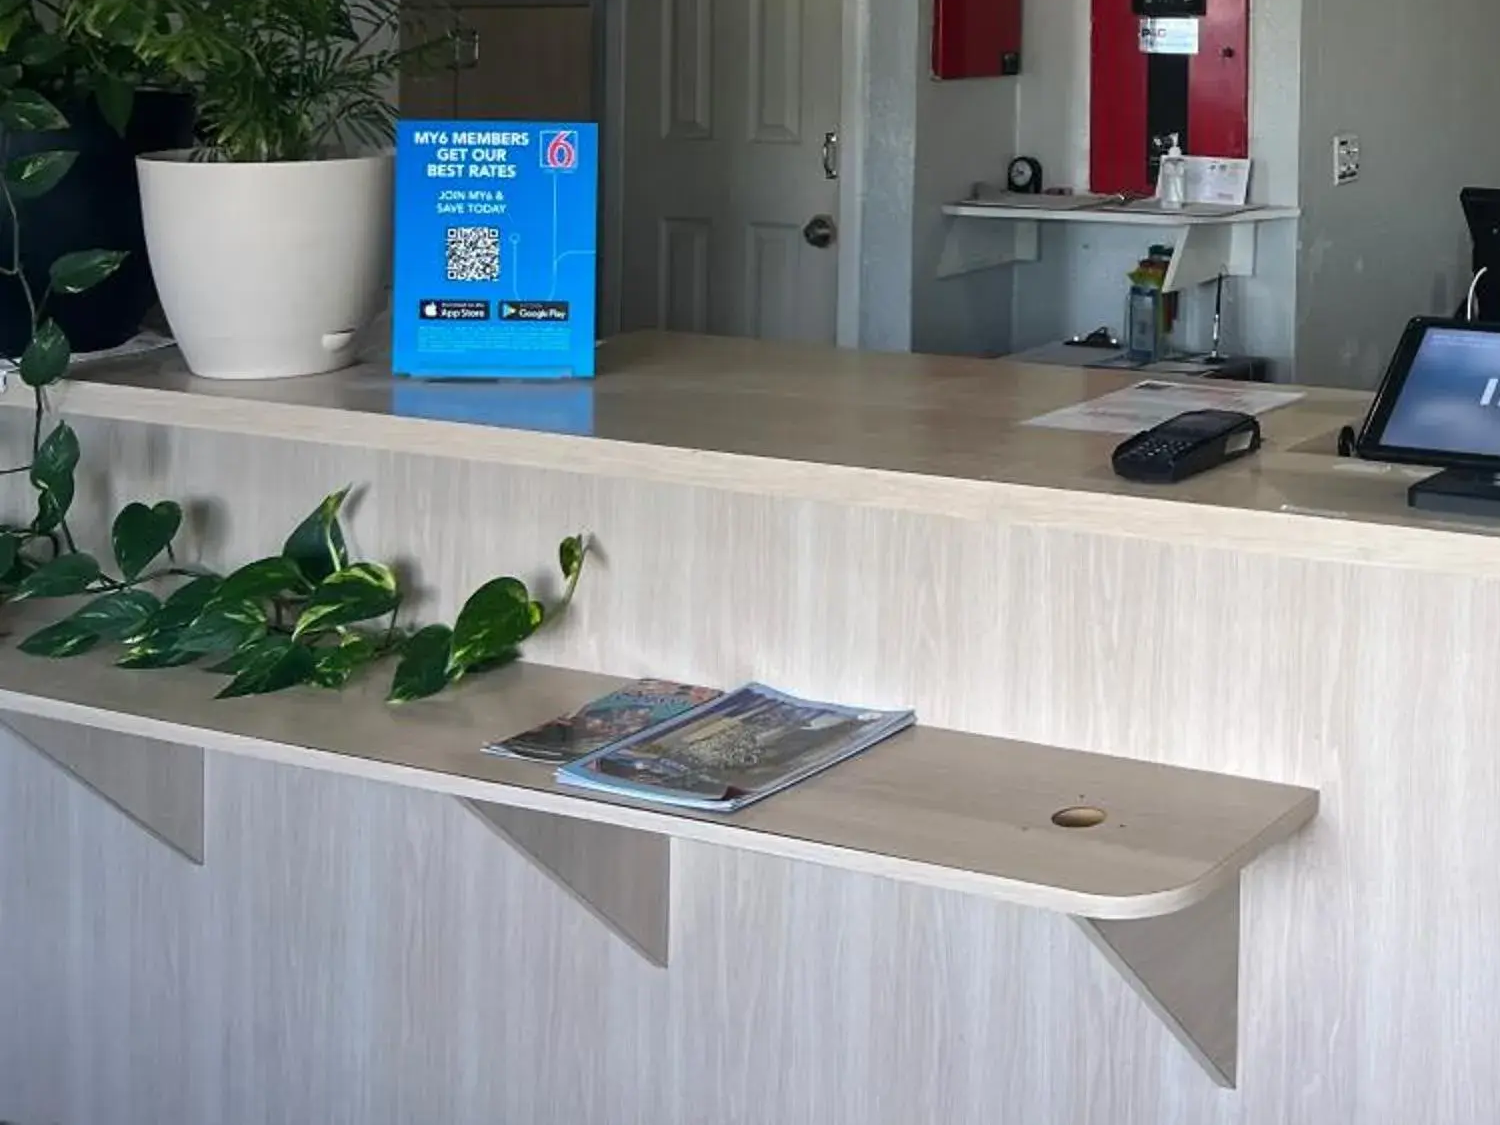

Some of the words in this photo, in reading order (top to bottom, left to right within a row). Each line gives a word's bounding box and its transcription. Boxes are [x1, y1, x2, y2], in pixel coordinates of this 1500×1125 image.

[415, 131, 449, 145] MY6
[452, 132, 529, 145] MEMBERS
[437, 148, 468, 162] GET
[471, 148, 507, 162] OUR
[547, 130, 575, 168] 6
[427, 164, 465, 177] BEST
[469, 164, 517, 178] RATES
[438, 190, 466, 200] JOIN
[437, 203, 464, 214] SAVE
[468, 203, 507, 214] TODAY
[441, 308, 460, 319] App
[461, 308, 485, 318] Store
[519, 308, 547, 319] Google
[549, 308, 566, 319] Play
